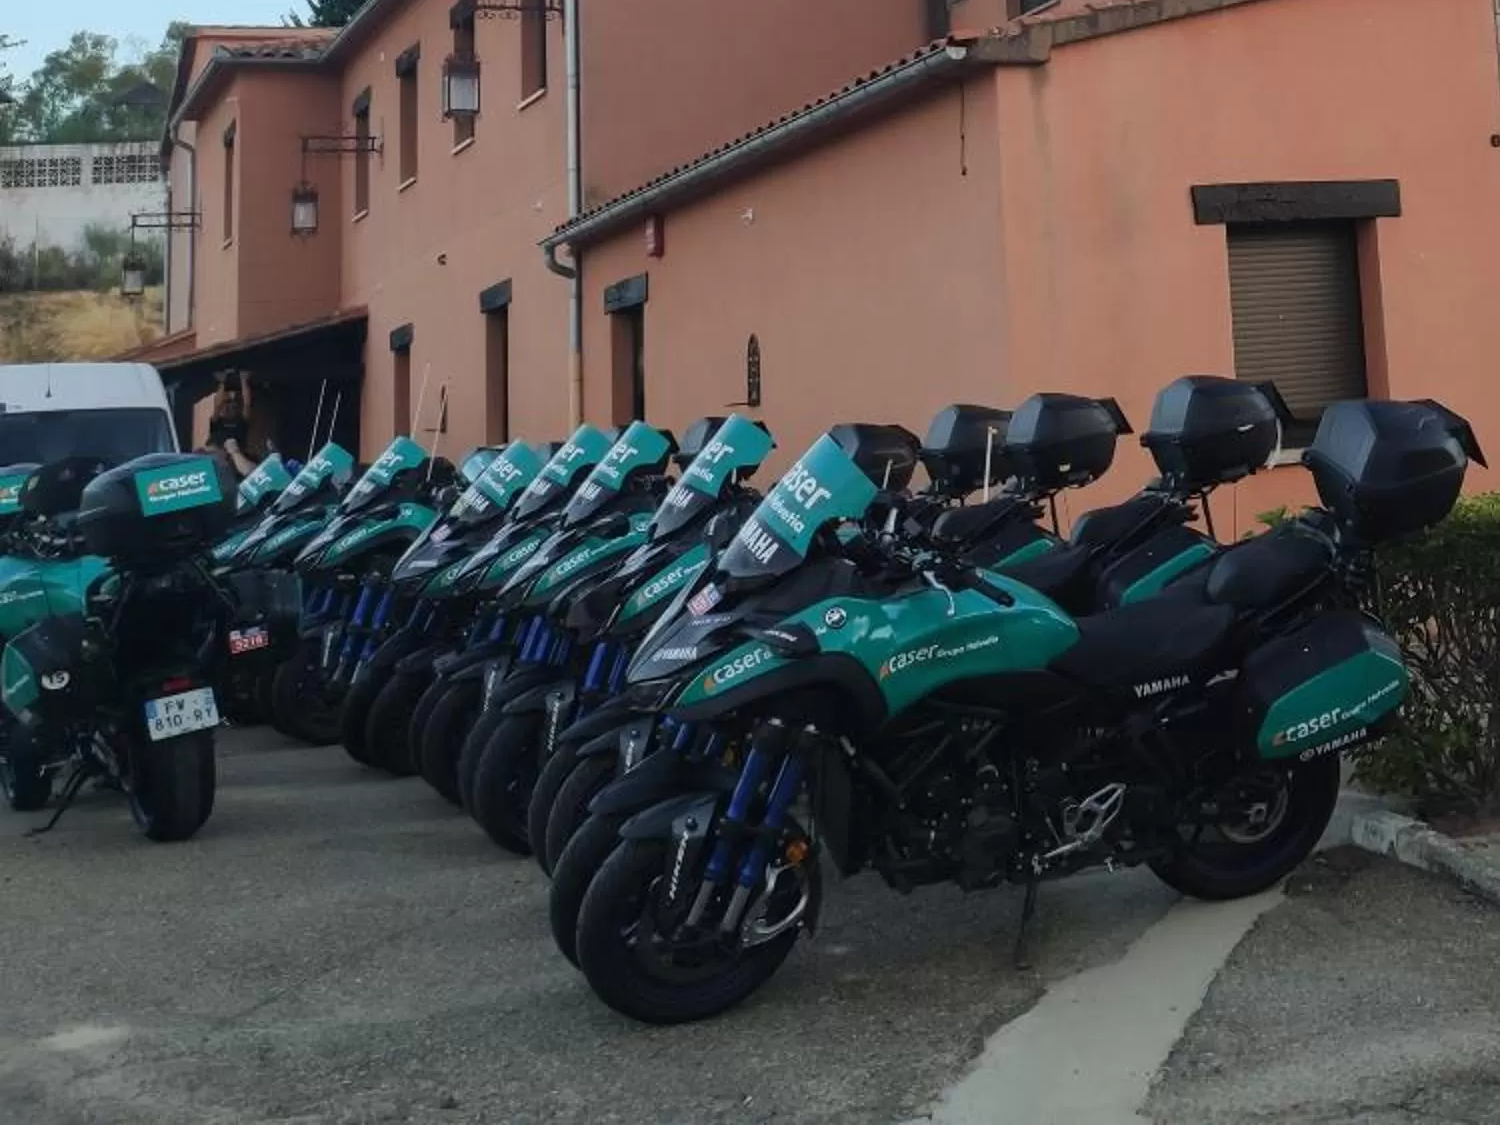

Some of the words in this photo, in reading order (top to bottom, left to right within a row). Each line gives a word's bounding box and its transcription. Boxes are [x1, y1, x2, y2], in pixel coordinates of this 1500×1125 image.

[643, 566, 685, 598] caser
[713, 647, 763, 684] caser
[888, 643, 939, 674] caser
[1133, 674, 1192, 699] YAMAHA
[1285, 706, 1342, 743] caser
[1315, 727, 1368, 756] YAMAHA
